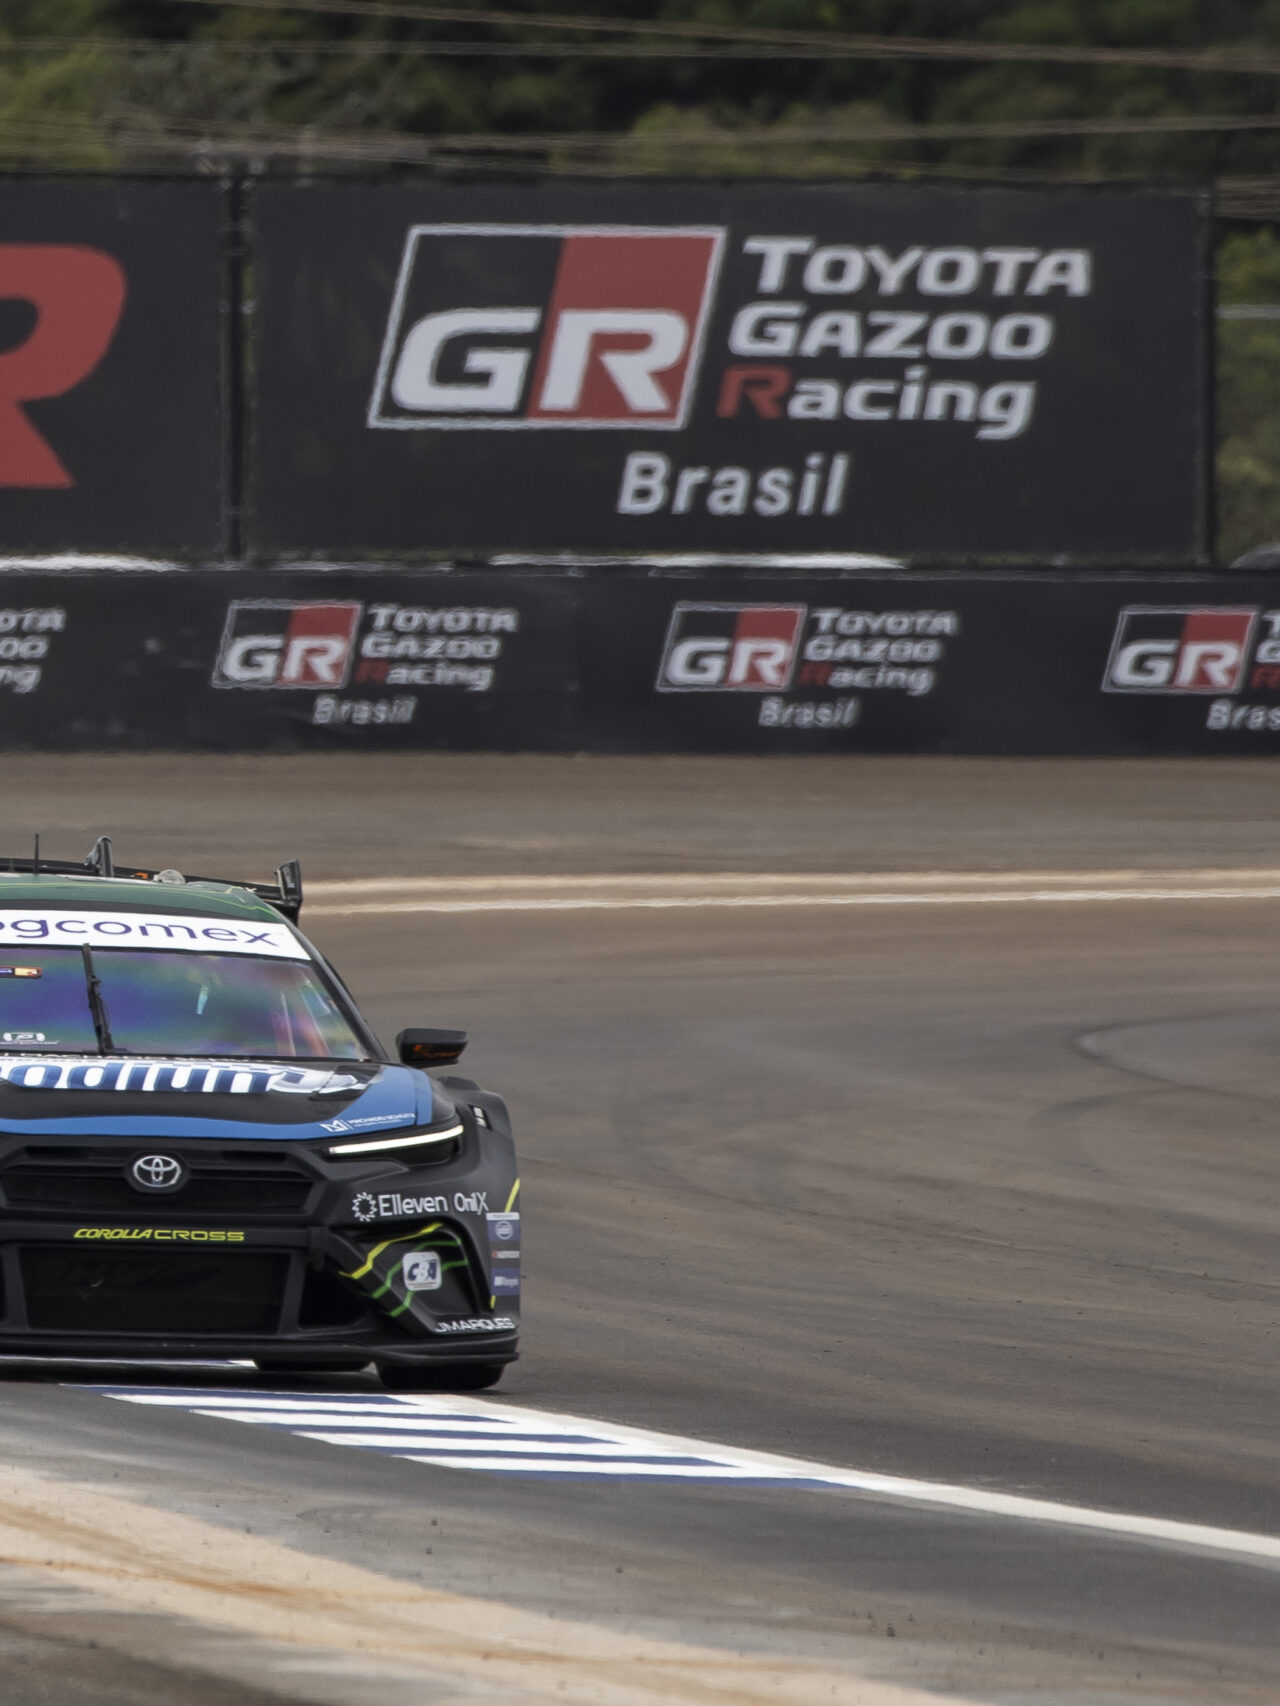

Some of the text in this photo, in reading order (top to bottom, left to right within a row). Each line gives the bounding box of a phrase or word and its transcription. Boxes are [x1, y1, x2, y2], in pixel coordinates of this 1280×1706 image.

[743, 236, 1093, 297] TOYOTA
[728, 302, 1053, 359] GAZOO
[392, 307, 688, 412] GR
[716, 365, 1036, 440] Racing
[616, 452, 849, 516] Brasil
[369, 603, 518, 632] TOYOTA
[809, 607, 959, 635] TOYOTA
[222, 635, 349, 682] GR
[361, 631, 502, 658] GAZOO
[665, 637, 792, 684] GR
[802, 635, 942, 662] GAZOO
[354, 659, 494, 691] Racing
[796, 661, 933, 695] Racing
[1111, 639, 1240, 688] GR
[312, 694, 418, 724] Brasil
[758, 696, 858, 726] Brasil
[1206, 699, 1280, 730] Bras
[379, 1193, 448, 1216] Elleven
[74, 1228, 245, 1241] COROLLA CROSS
